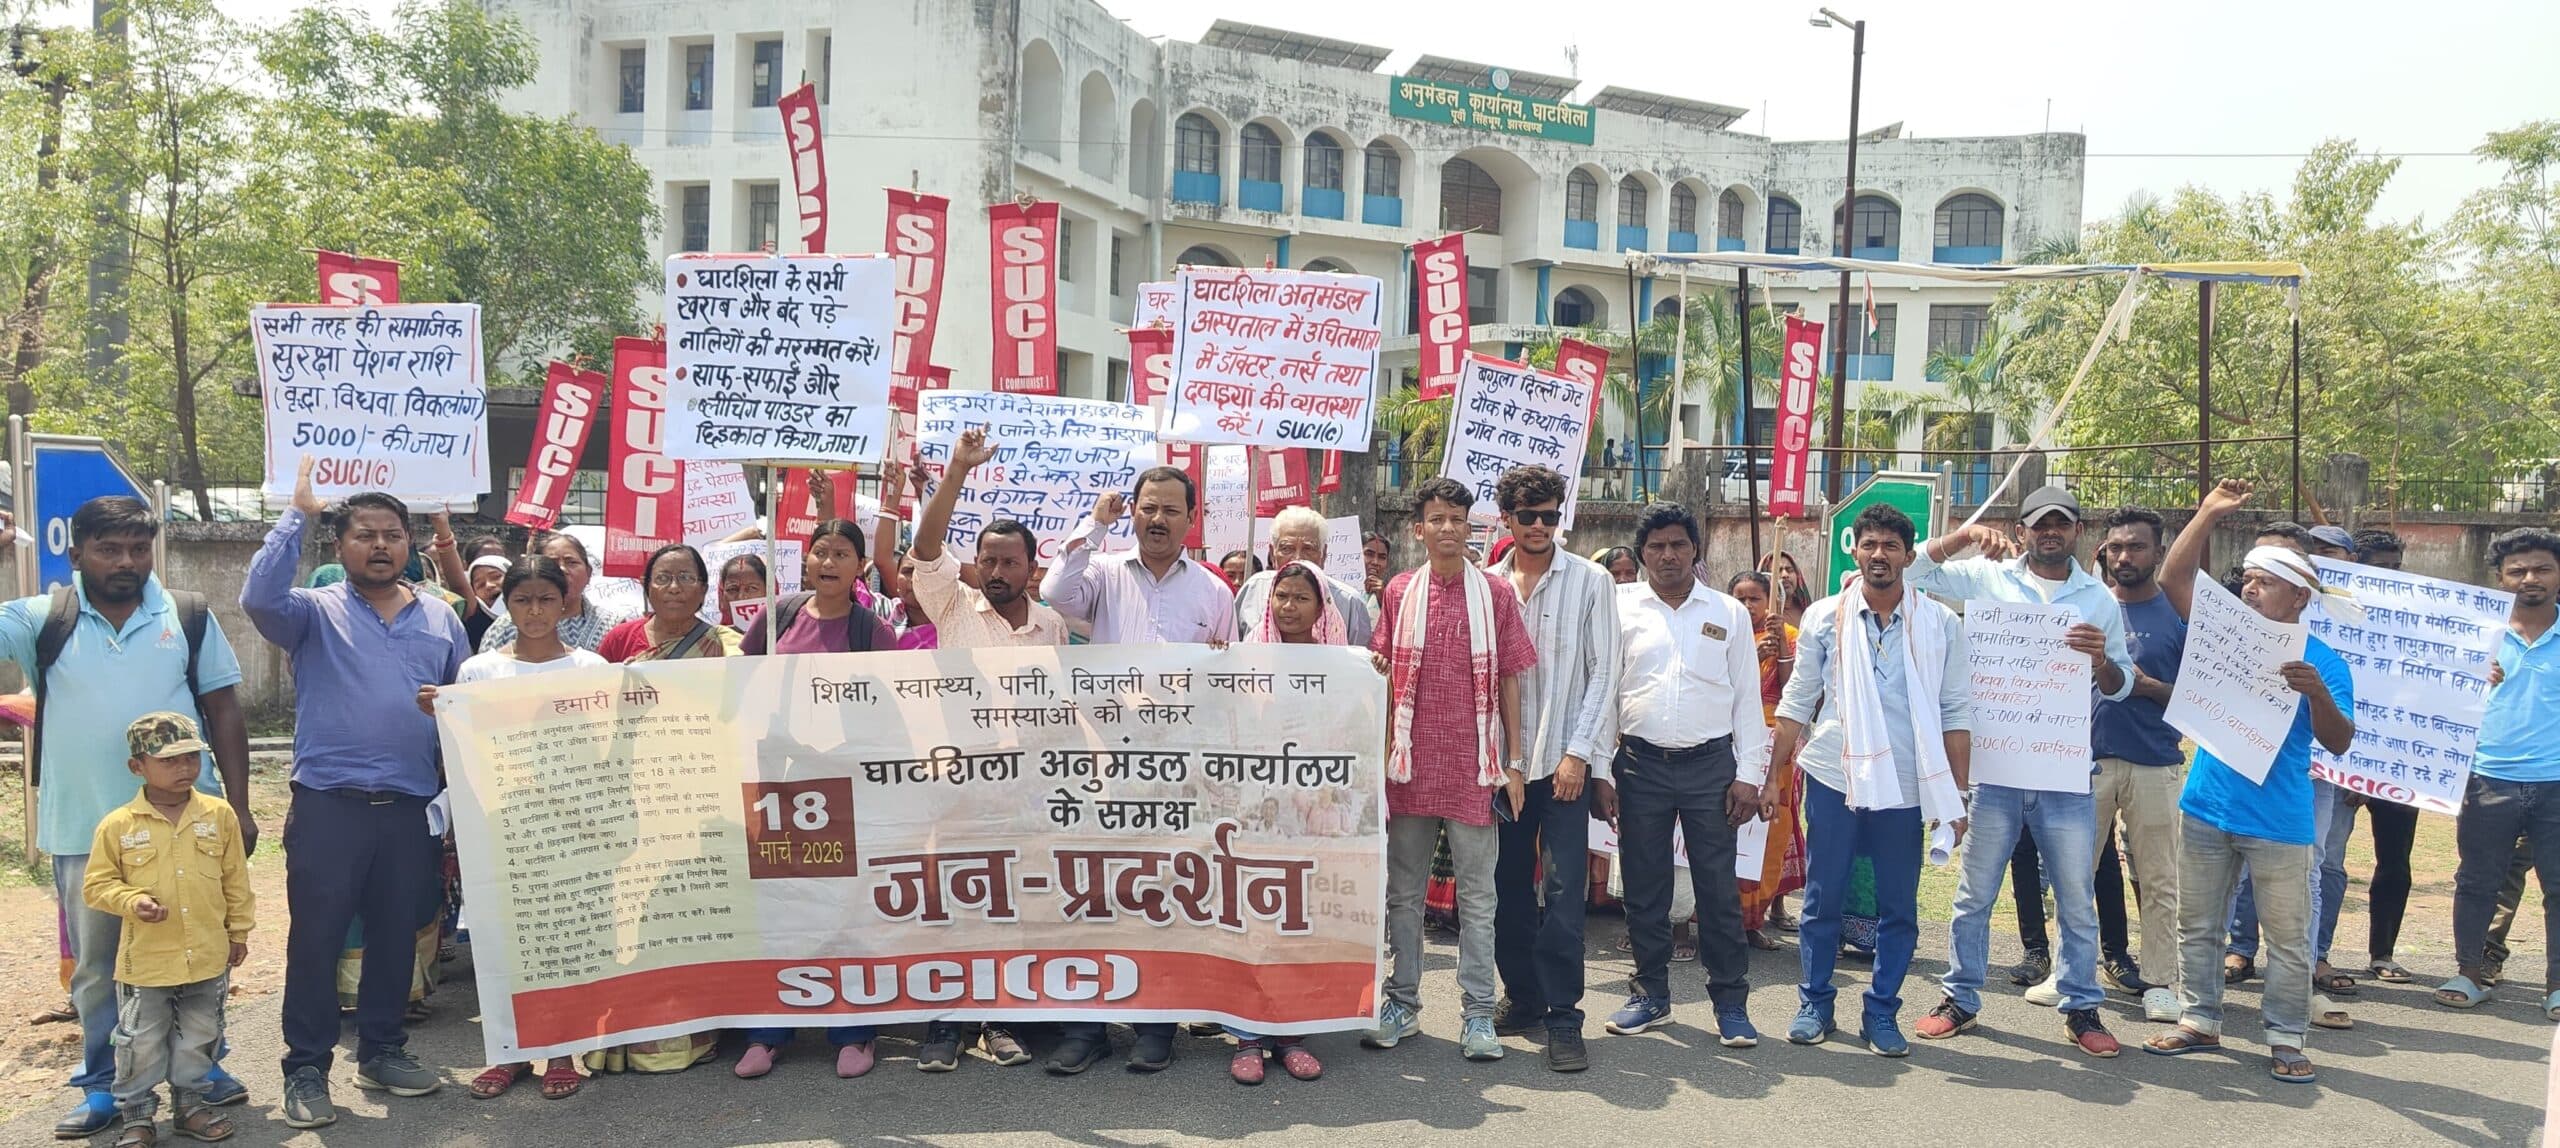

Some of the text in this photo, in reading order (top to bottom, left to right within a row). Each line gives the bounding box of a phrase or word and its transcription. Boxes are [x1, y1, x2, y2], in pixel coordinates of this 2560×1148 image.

[1400, 82, 1459, 107] अनुमंडल
[1533, 102, 1588, 127] घाटशिला
[695, 263, 848, 295] घाटशिला के सभी
[892, 213, 934, 374] SUCI
[1194, 274, 1371, 315] घाटशिला अनुमंडल
[677, 295, 737, 324] खराब
[740, 291, 772, 320] और
[777, 296, 803, 328] बंद
[1002, 226, 1046, 376] SUCI
[1425, 252, 1462, 374] SUCI
[262, 310, 386, 340] सभी तरह की
[746, 327, 774, 357] की
[1191, 311, 1282, 341] अस्पताल
[1284, 313, 1305, 341] में
[273, 340, 461, 383] सुरक्षा पेंशन राशि
[1196, 342, 1218, 370] में
[1324, 364, 1369, 387] तथा
[804, 364, 840, 401] और
[1260, 383, 1290, 411] की
[1291, 393, 1365, 419] व्यवस्था
[1478, 366, 1518, 393] बगुला
[1562, 383, 1584, 407] गेट
[764, 399, 821, 428] पाउडर
[825, 405, 857, 428] का
[1040, 420, 1057, 439] के
[1504, 399, 1521, 424] से
[1782, 342, 1814, 489] SUCI
[294, 423, 411, 453] 5000/- की
[532, 382, 592, 506] SUCI
[774, 425, 821, 452] किया
[920, 441, 948, 459] का
[1498, 429, 1524, 448] तक
[2374, 657, 2395, 677] का
[553, 690, 610, 714] हमारी
[811, 666, 1328, 706] शिक्षा, स्वास्थ्य, पानी, बिजली एवं ज्वलंत जन
[970, 697, 1196, 728] समस्याओं को लेकर
[859, 736, 1357, 793] घाटशिला अनुमंडल कार्यालय
[753, 791, 829, 831] 18
[1048, 788, 1197, 833] के समक्ष
[758, 831, 844, 864] मार्च 2026
[868, 819, 1314, 933] जन-प्रदर्शन
[777, 953, 1138, 1007] SUCI(C)
